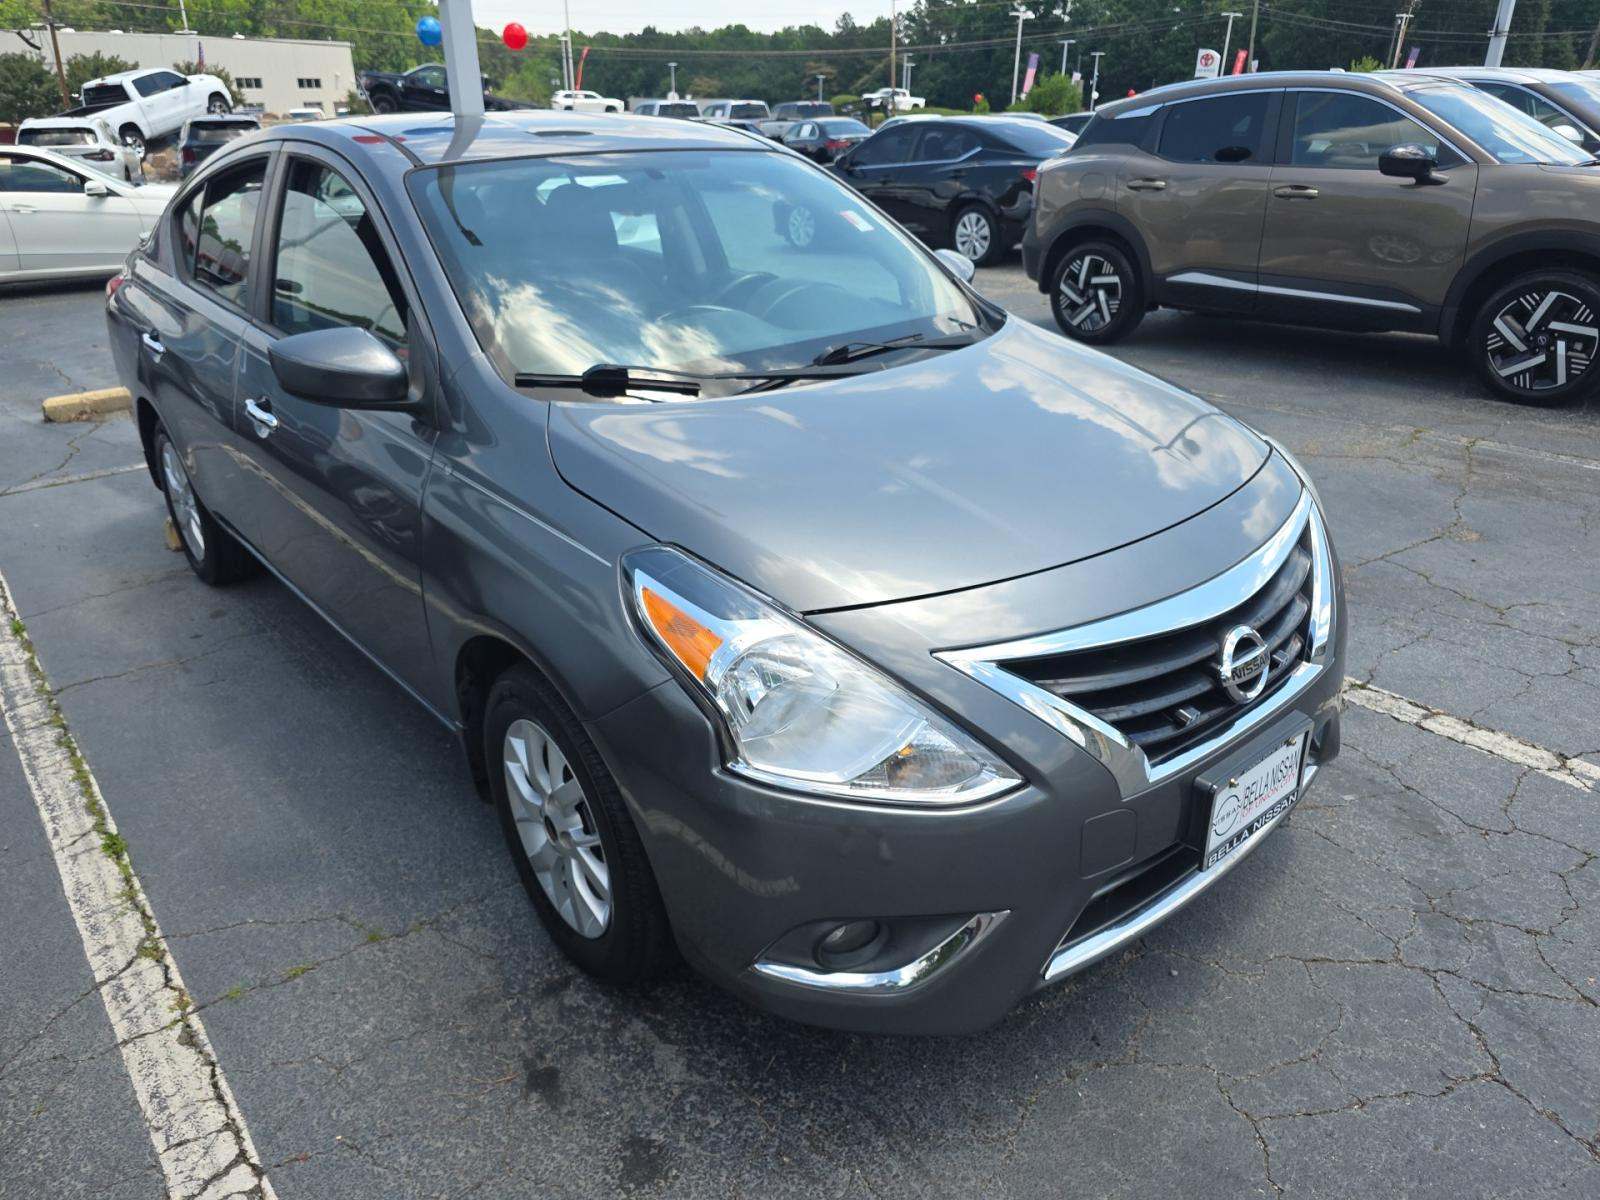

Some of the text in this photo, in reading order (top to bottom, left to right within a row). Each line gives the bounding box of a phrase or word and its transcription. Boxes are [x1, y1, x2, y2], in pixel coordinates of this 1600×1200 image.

[1231, 650, 1270, 681] NISSAN
[1243, 748, 1299, 809] BELLA NISSAN
[1208, 790, 1298, 868] BELLA NISSAN
[1212, 803, 1242, 828] NISSAN
